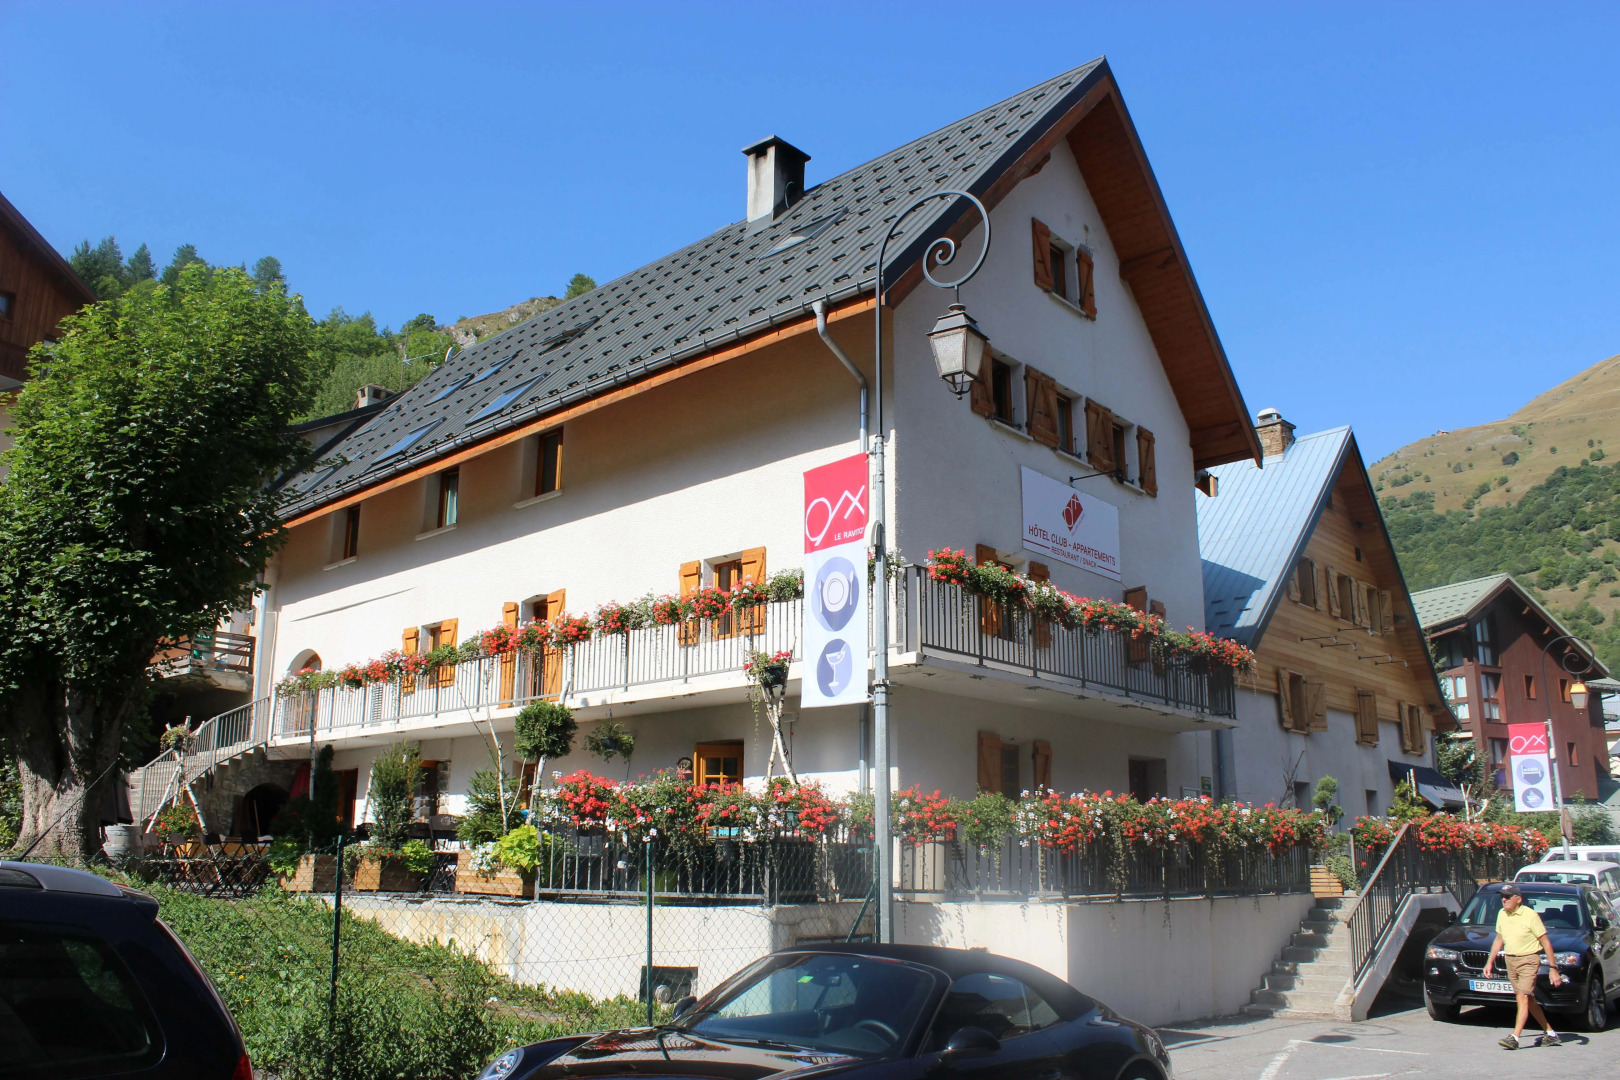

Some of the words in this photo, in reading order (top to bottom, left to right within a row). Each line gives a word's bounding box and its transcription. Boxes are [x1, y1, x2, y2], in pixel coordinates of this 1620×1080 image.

[834, 532, 842, 540] LE
[1028, 524, 1050, 541] HÔTEL
[1051, 533, 1068, 548] CLUB
[1072, 541, 1116, 566] APPARTEMENTS
[1051, 546, 1080, 562] RESTAURANT
[1082, 557, 1098, 569] SNACK
[1475, 982, 1484, 990] EP
[1486, 982, 1501, 990] 073
